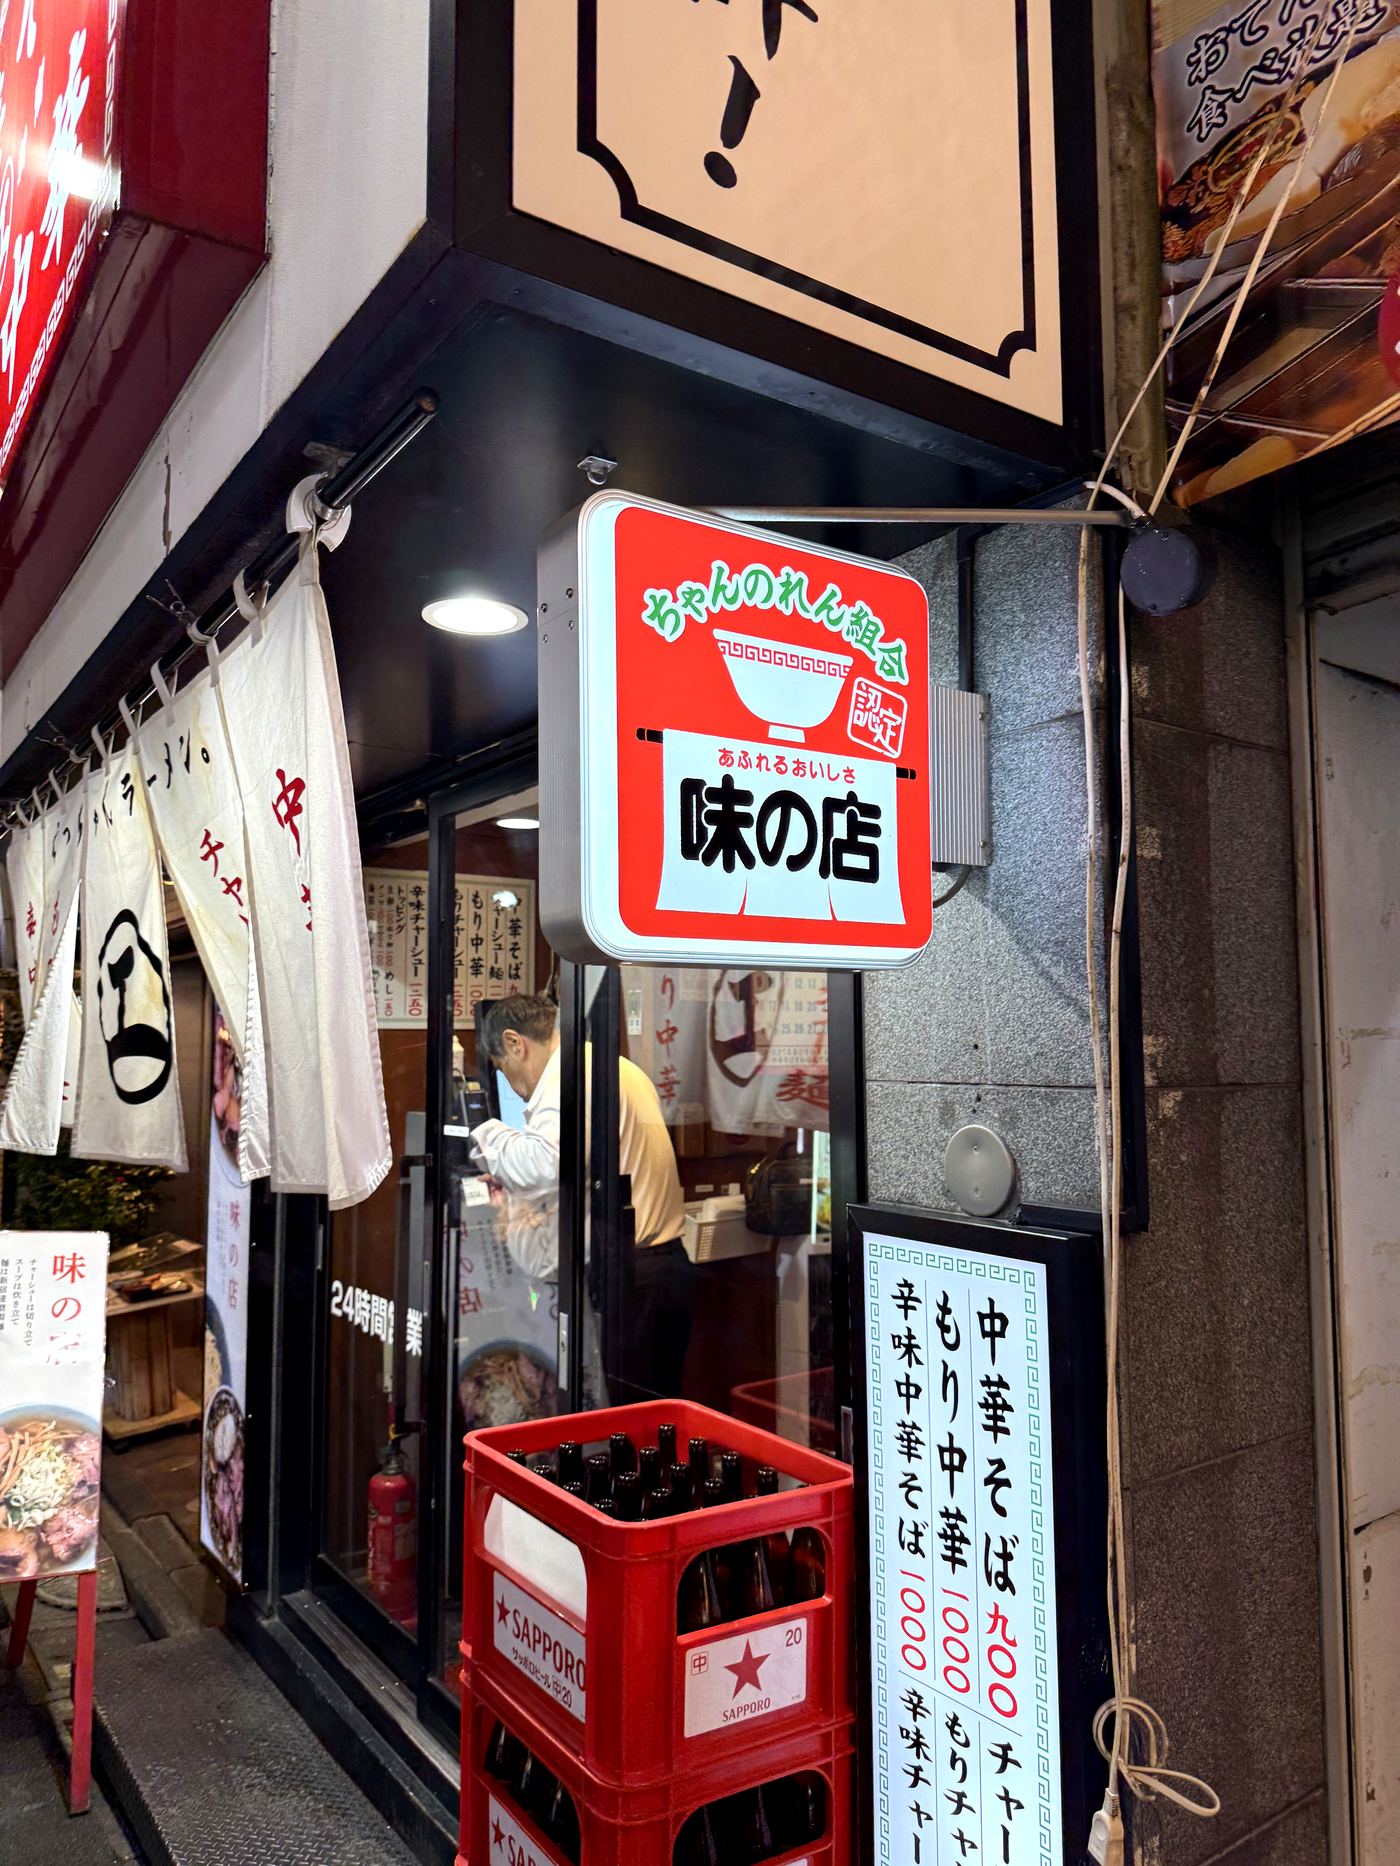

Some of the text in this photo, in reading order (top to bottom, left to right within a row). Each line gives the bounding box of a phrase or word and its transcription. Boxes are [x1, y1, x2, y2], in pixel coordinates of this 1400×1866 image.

[645, 563, 907, 682] ちゃんのれん組合
[853, 681, 903, 756] 認定
[718, 747, 857, 785] あふれるおいしさ
[680, 774, 882, 884] 味の店
[395, 885, 406, 935] トッピング
[409, 885, 425, 978] 辛味チャーシュー
[470, 889, 485, 979] もり中華
[889, 1277, 930, 1671] 辛味中華そば 一〇〇〇
[935, 1289, 972, 1694] もり中華 一〇〇〇
[976, 1296, 1020, 1719] 中華そば 九〇〇
[512, 1608, 585, 1692] SAPPORO
[785, 1627, 802, 1648] 20
[562, 1686, 572, 1709] 20
[722, 1697, 771, 1722] SAPPORO
[898, 1687, 934, 1865] 辛味チャー
[944, 1710, 979, 1866] もりチャ
